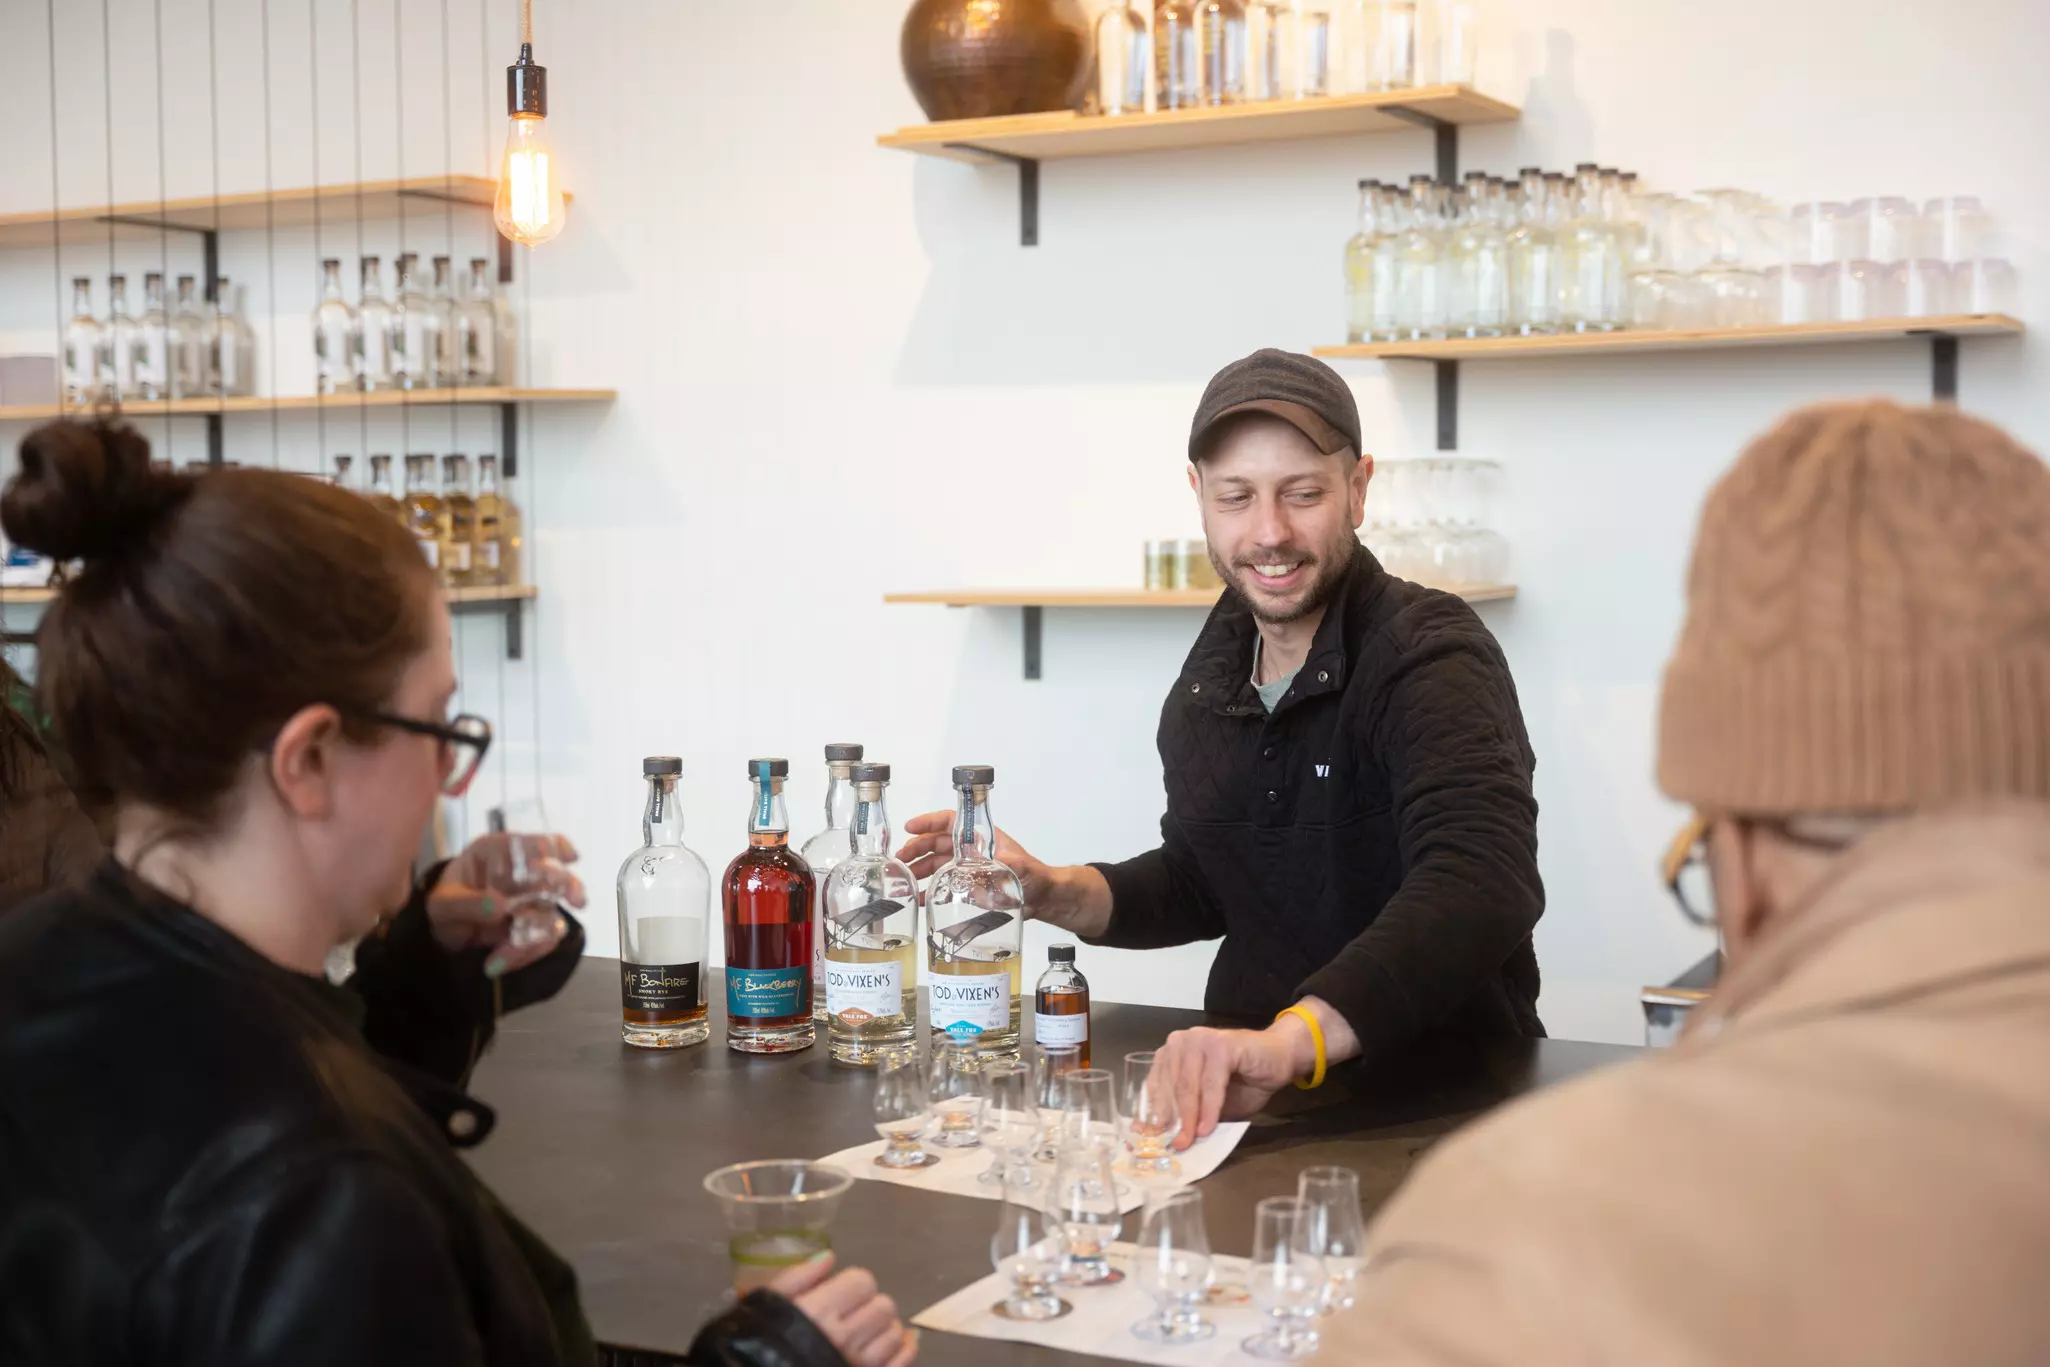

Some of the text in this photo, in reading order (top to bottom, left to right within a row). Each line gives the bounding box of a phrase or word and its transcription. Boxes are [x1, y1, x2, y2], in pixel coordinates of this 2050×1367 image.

[827, 971, 843, 987] TOD
[848, 973, 891, 988] VIXEN'S
[932, 984, 951, 1000] TOD
[956, 985, 1000, 1001] VIXEN'S
